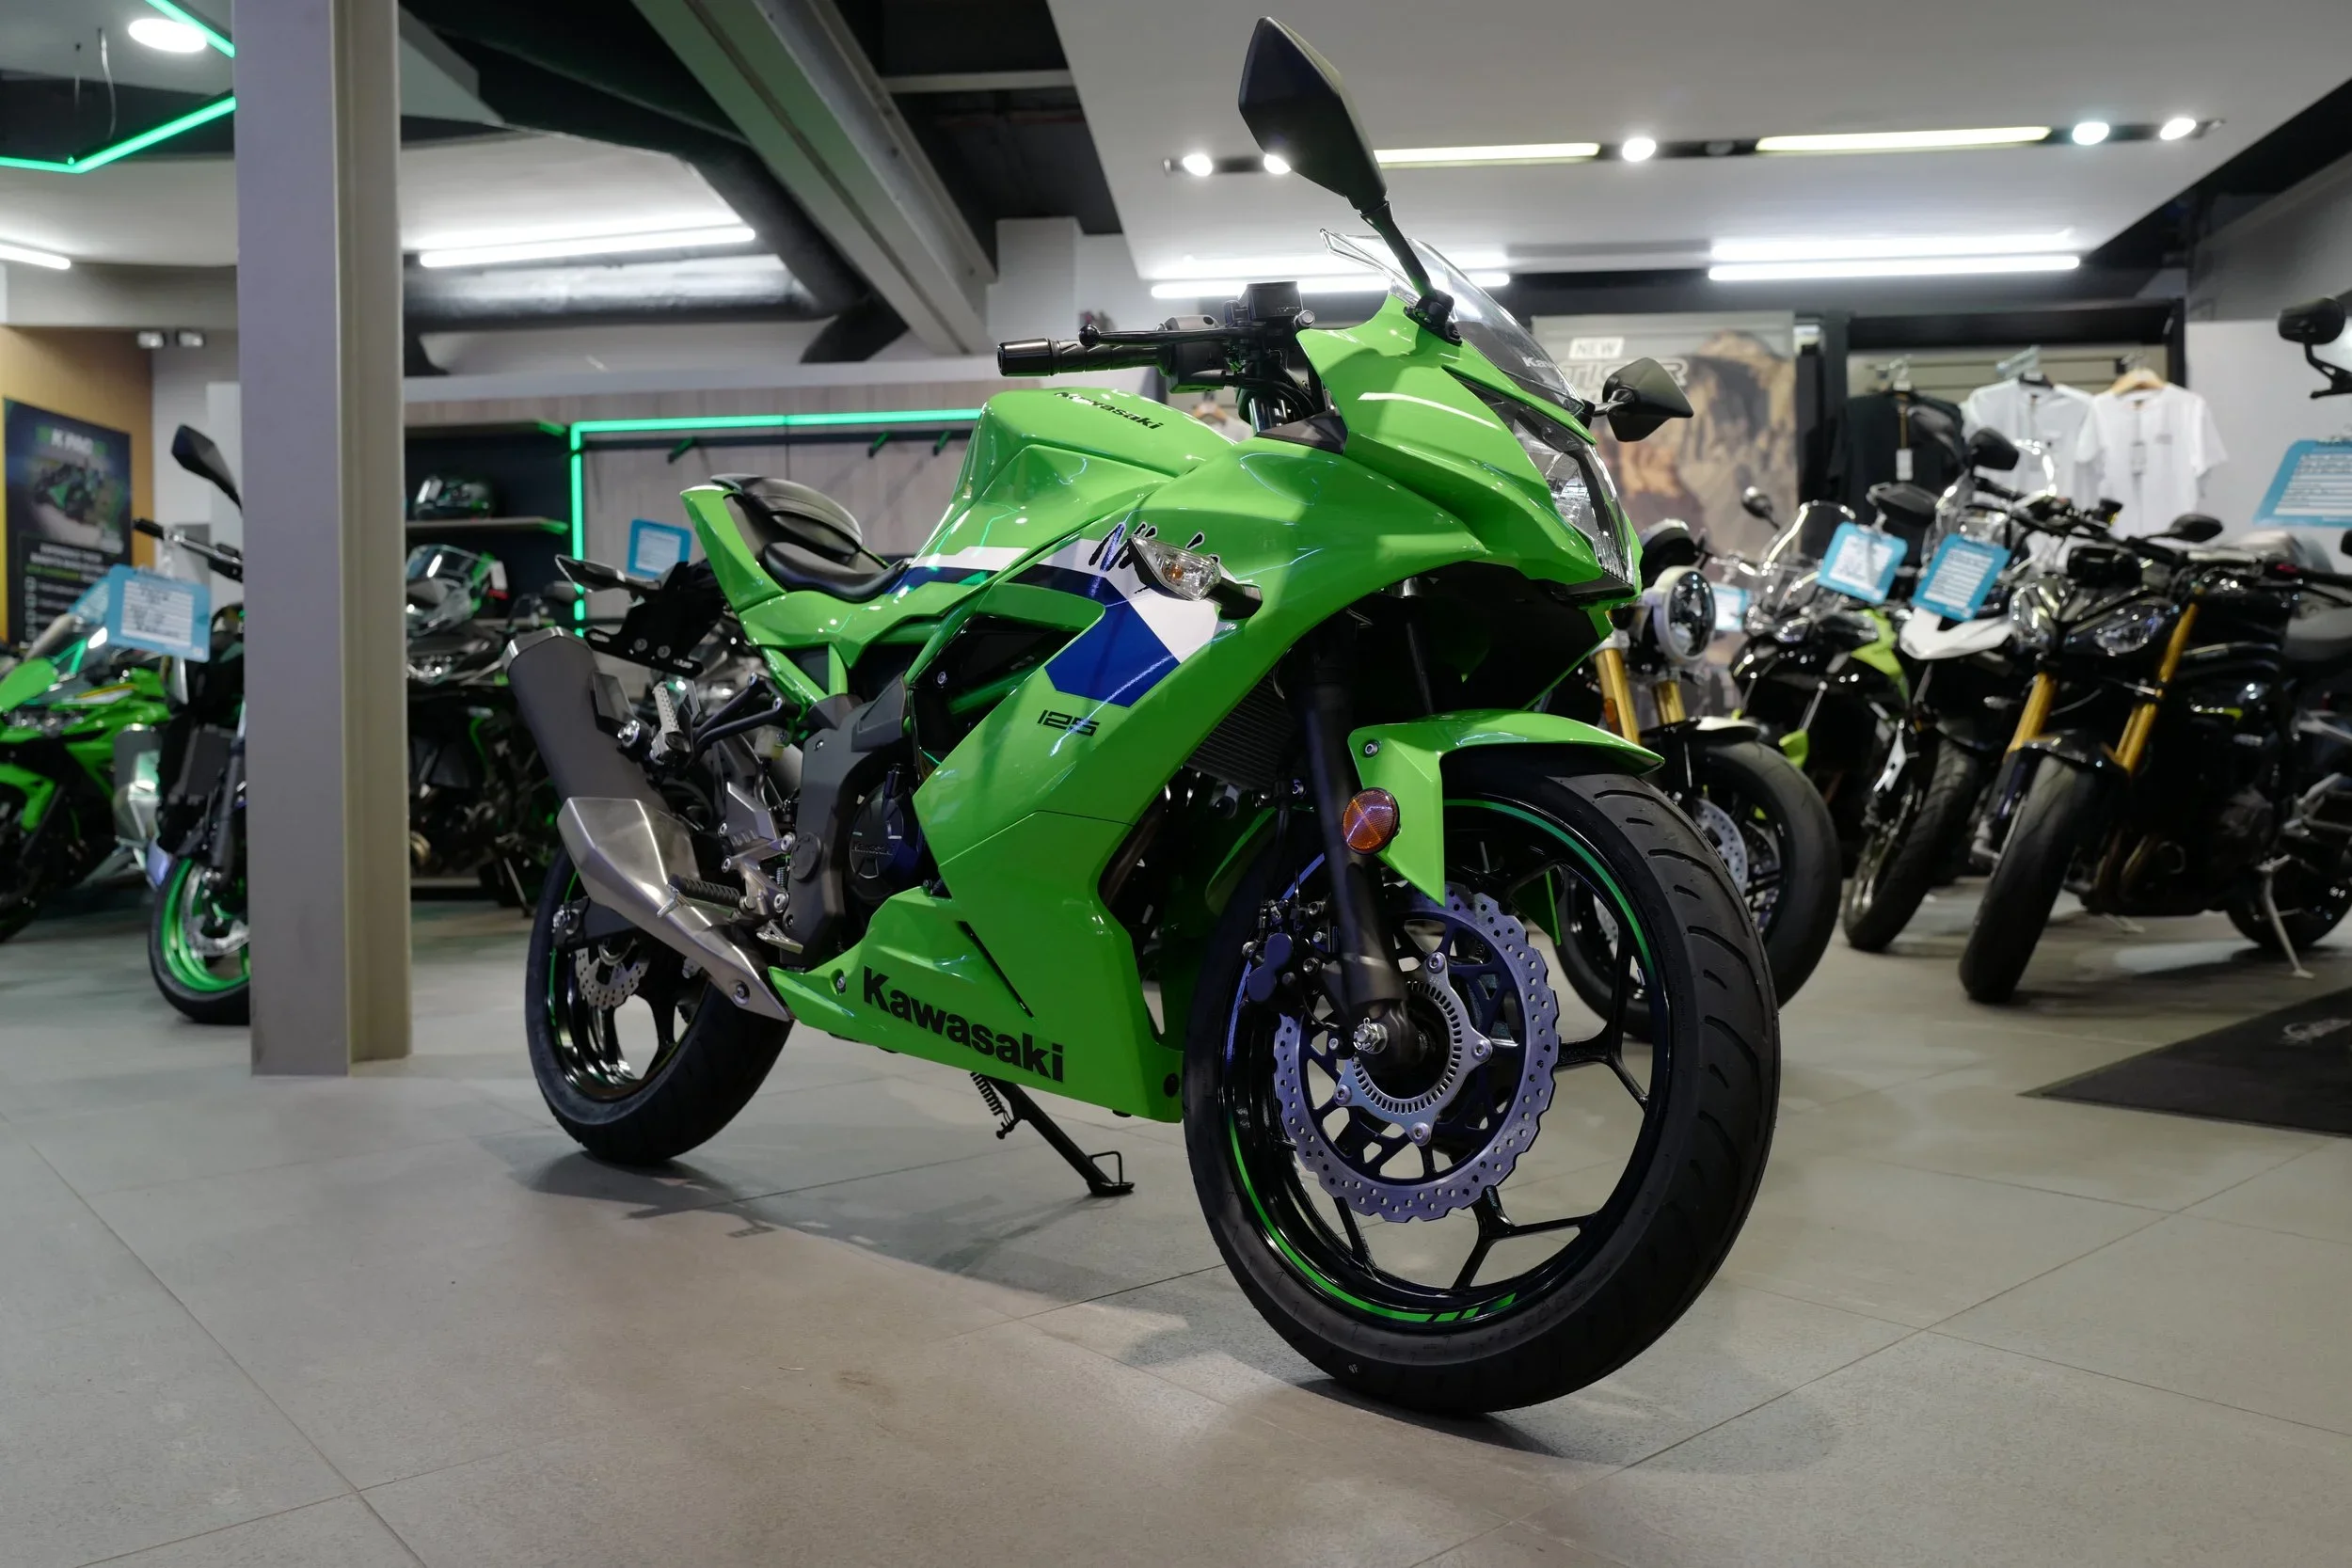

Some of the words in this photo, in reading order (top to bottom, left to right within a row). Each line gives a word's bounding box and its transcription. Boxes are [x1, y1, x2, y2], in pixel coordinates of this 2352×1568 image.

[1575, 341, 1618, 356] NEW
[1037, 709, 1101, 736] 125
[863, 966, 1064, 1084] Kawasaki
